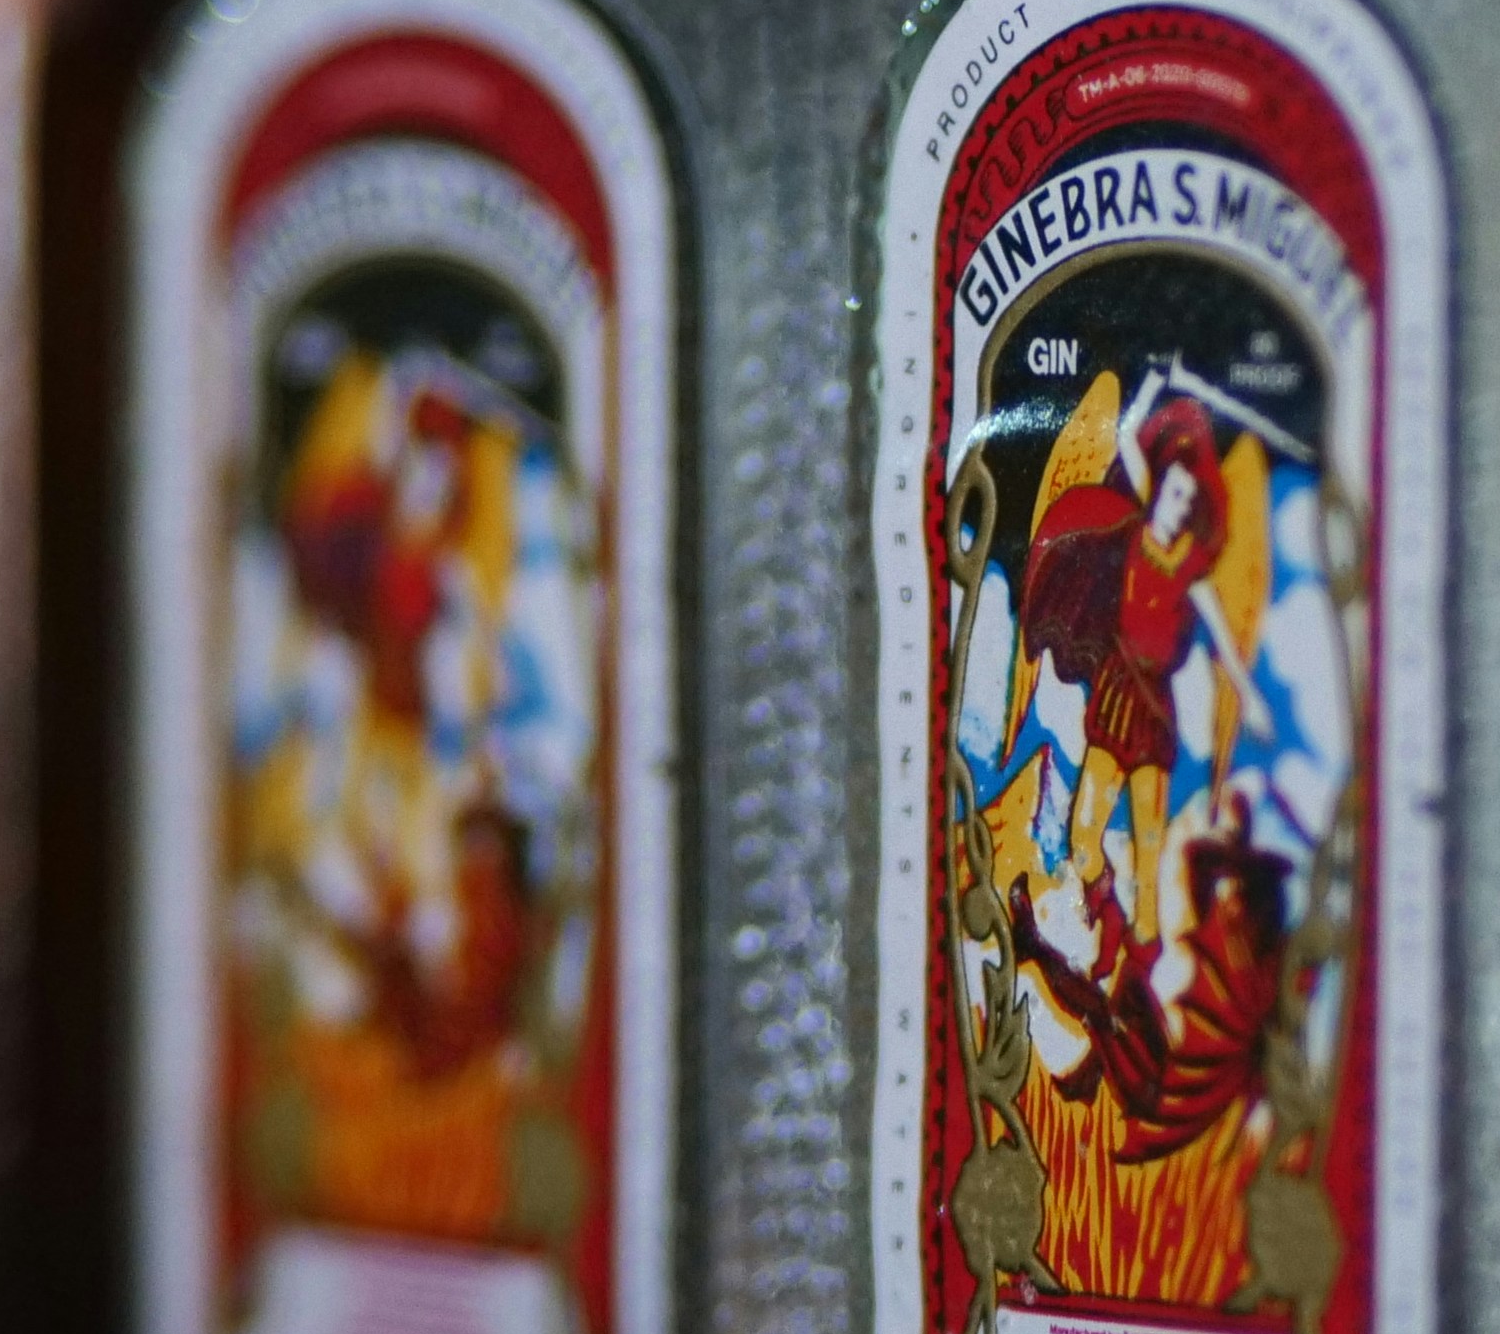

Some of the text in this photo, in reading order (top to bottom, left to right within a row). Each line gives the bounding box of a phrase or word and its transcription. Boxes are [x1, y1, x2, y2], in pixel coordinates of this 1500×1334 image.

[926, 3, 1031, 163] PRODUCT
[960, 160, 1159, 327] GINEBRA
[1028, 338, 1078, 375] GIN
